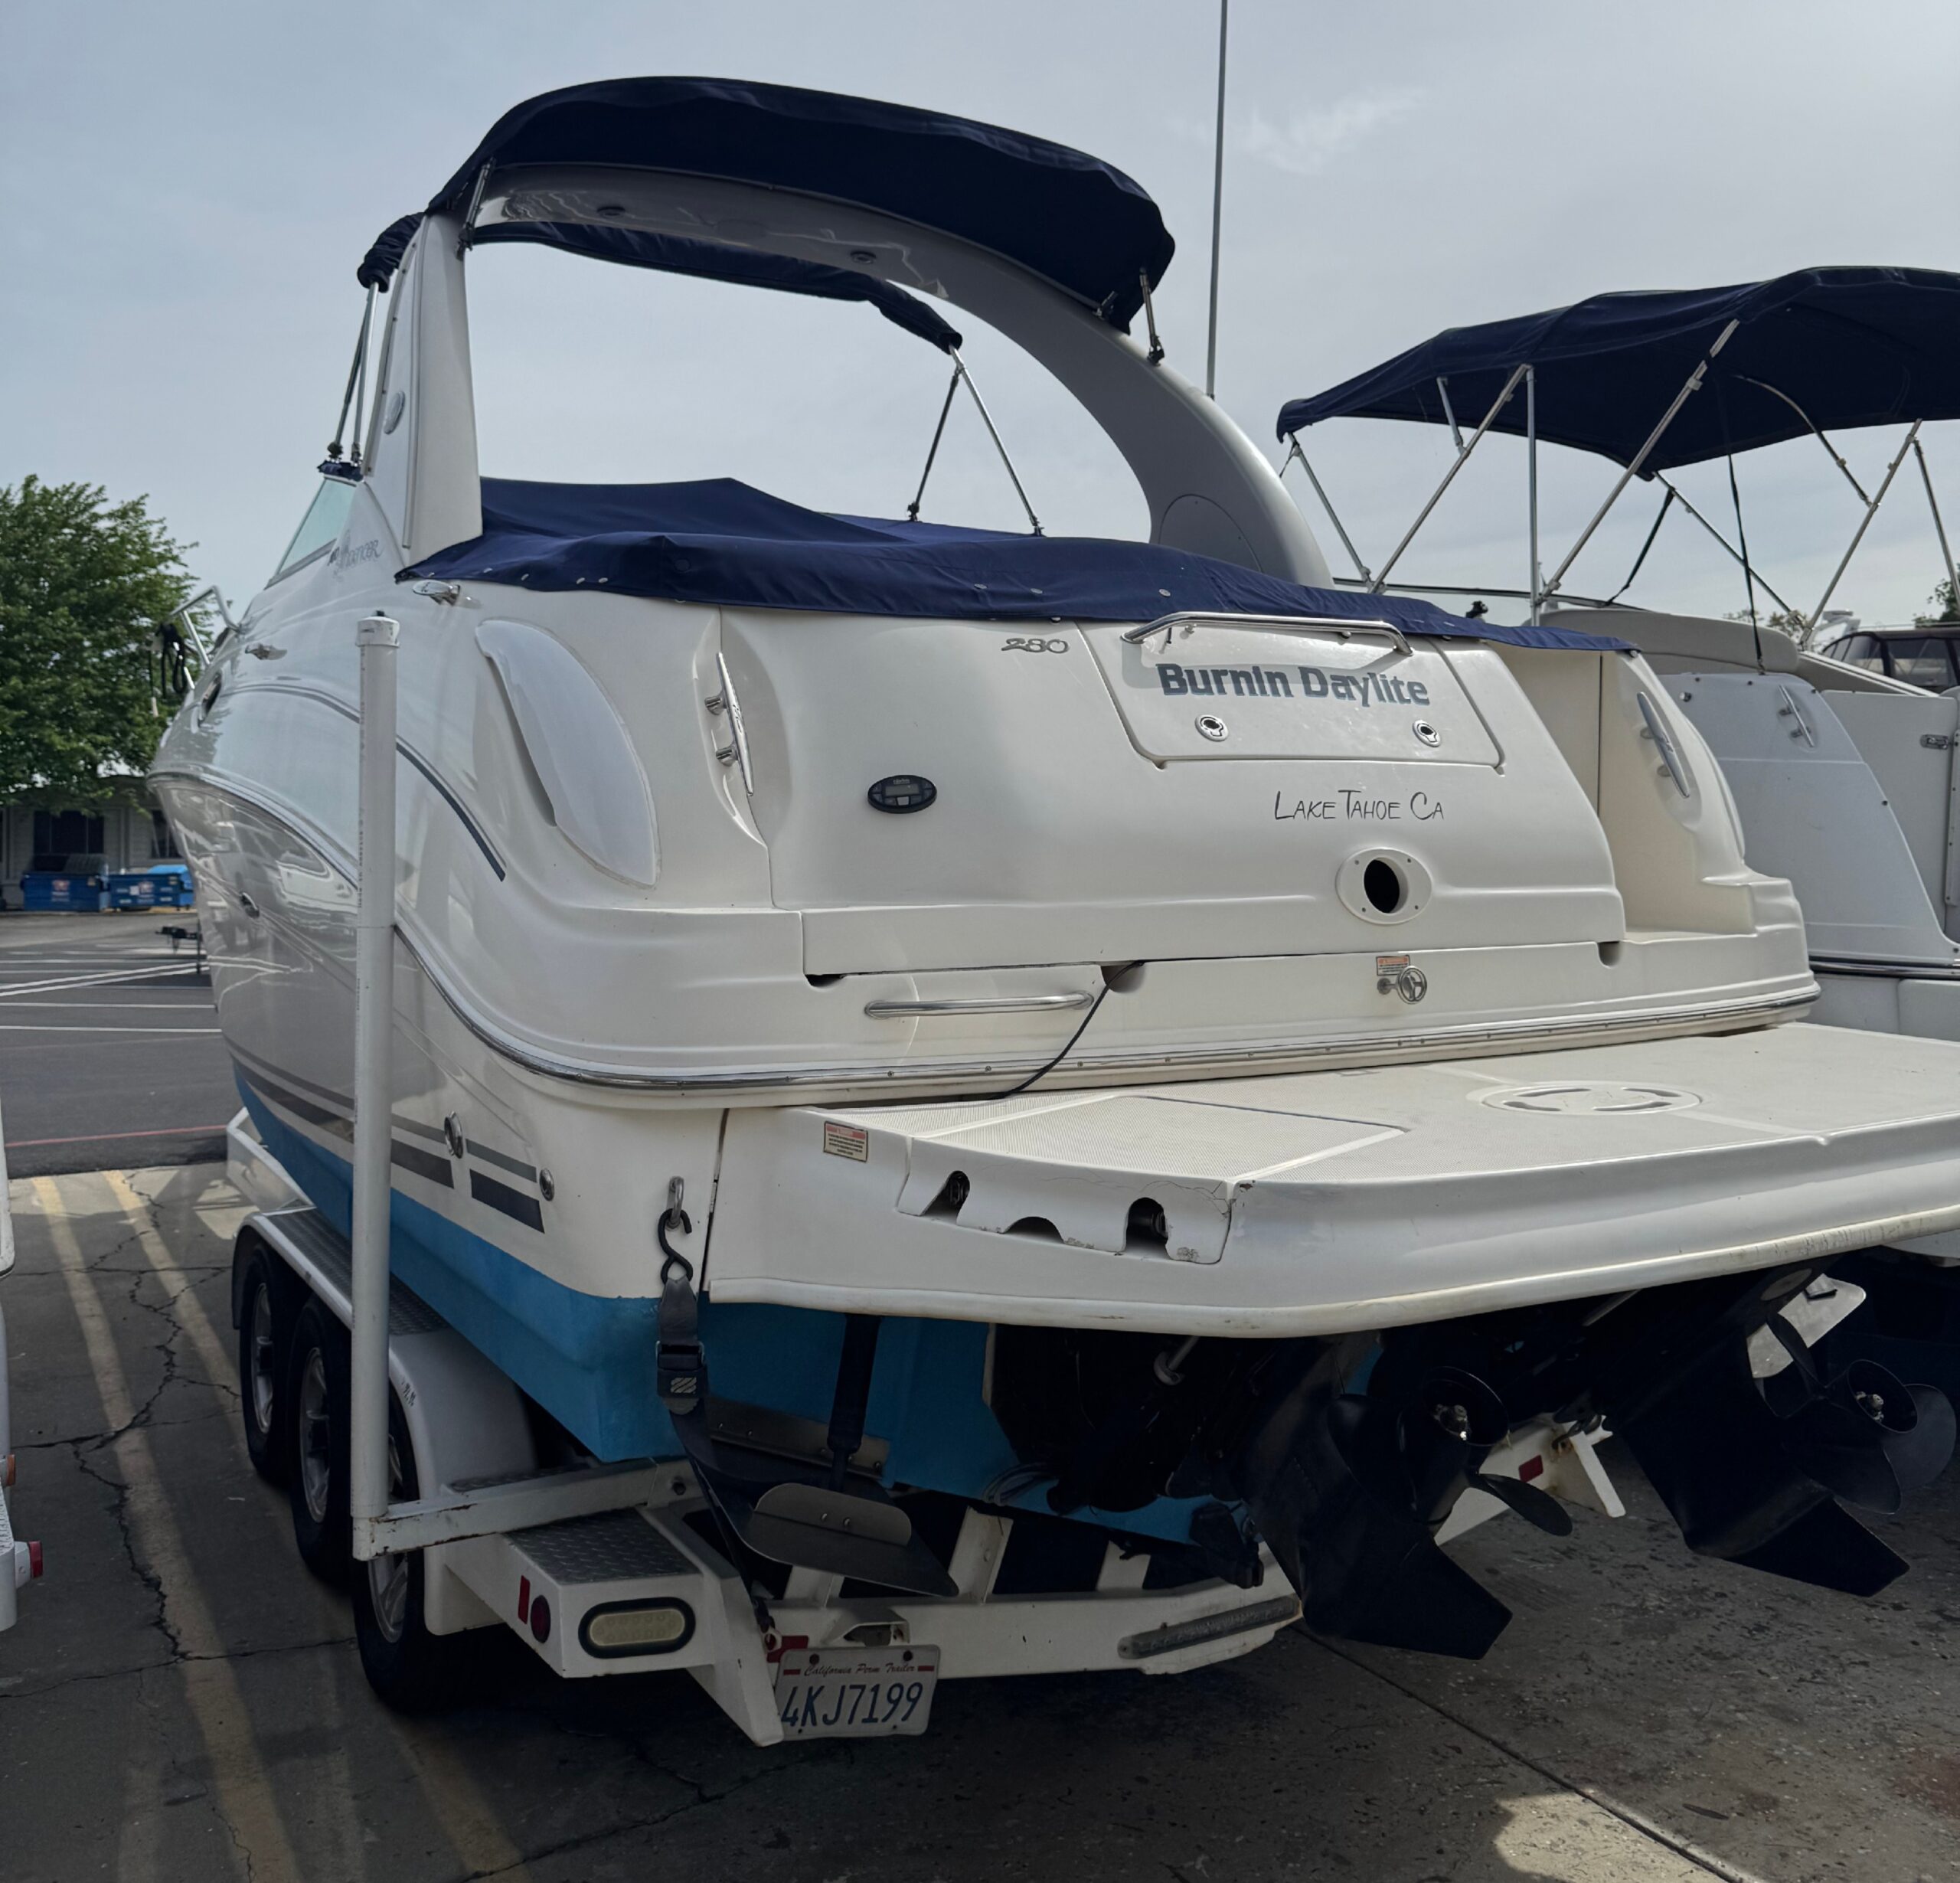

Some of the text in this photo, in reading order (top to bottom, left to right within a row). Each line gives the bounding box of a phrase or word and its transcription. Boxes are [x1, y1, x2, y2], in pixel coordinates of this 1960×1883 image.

[1001, 638, 1070, 654] 280
[1298, 666, 1431, 708] Daylite
[1275, 790, 1336, 821] LAKE
[1338, 789, 1401, 820] TAHOE
[804, 1665, 851, 1678] California
[855, 1662, 880, 1675] Perm
[781, 1681, 923, 1728] 4KJ7199
